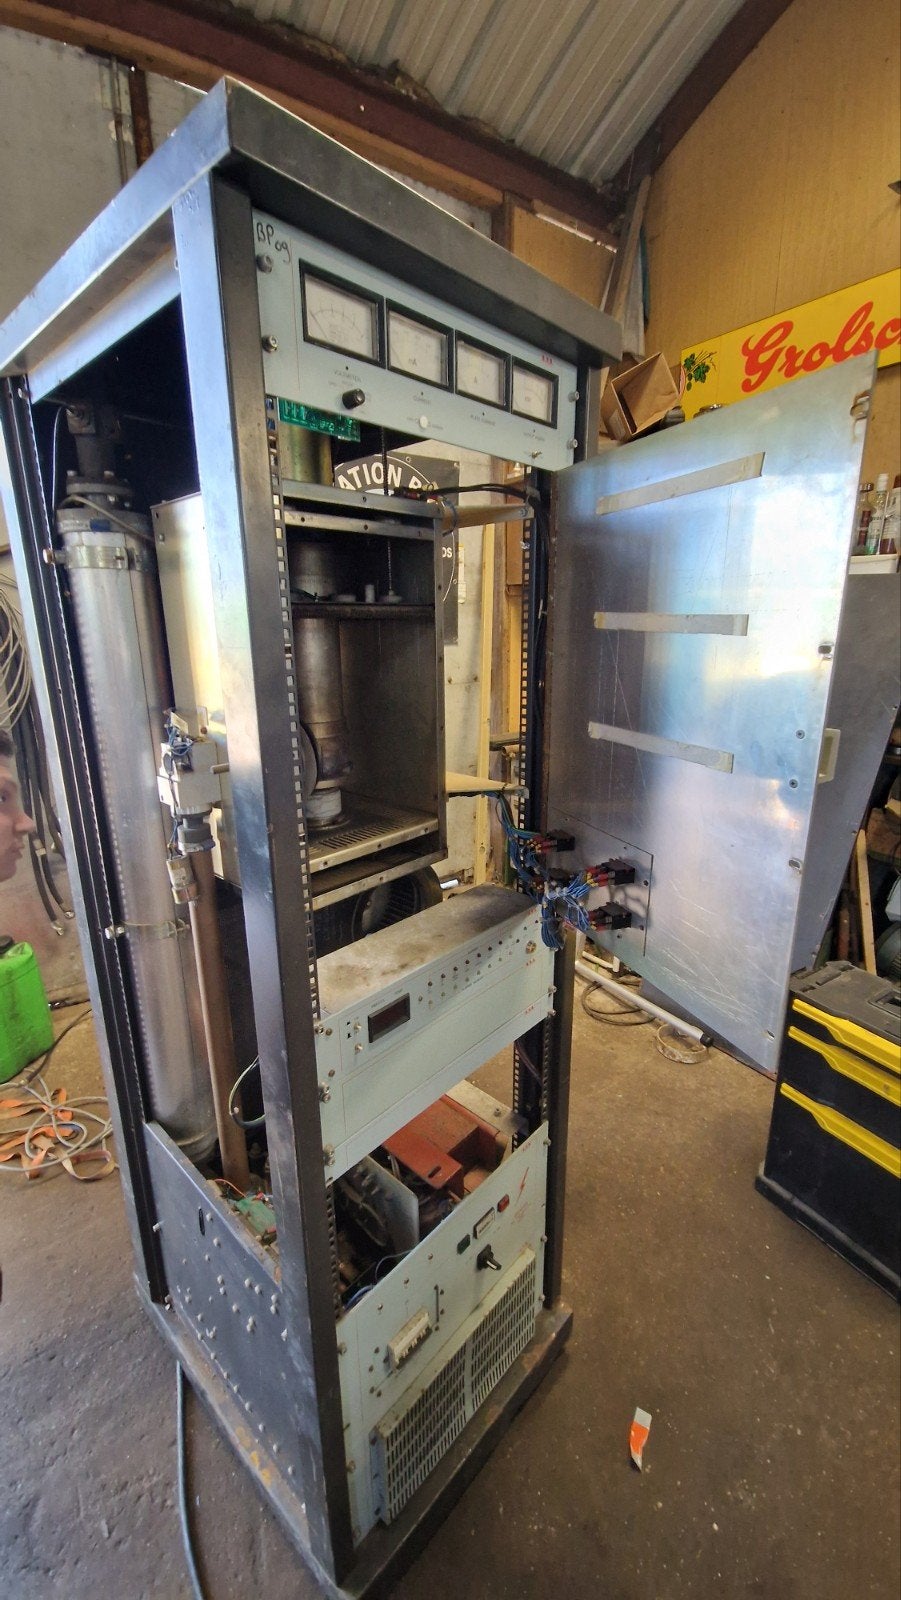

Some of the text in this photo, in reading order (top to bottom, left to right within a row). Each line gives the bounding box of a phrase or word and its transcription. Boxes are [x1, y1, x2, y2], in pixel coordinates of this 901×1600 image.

[256, 222, 275, 246] BP
[741, 301, 901, 393] Grolsc
[333, 461, 403, 491] ATION
